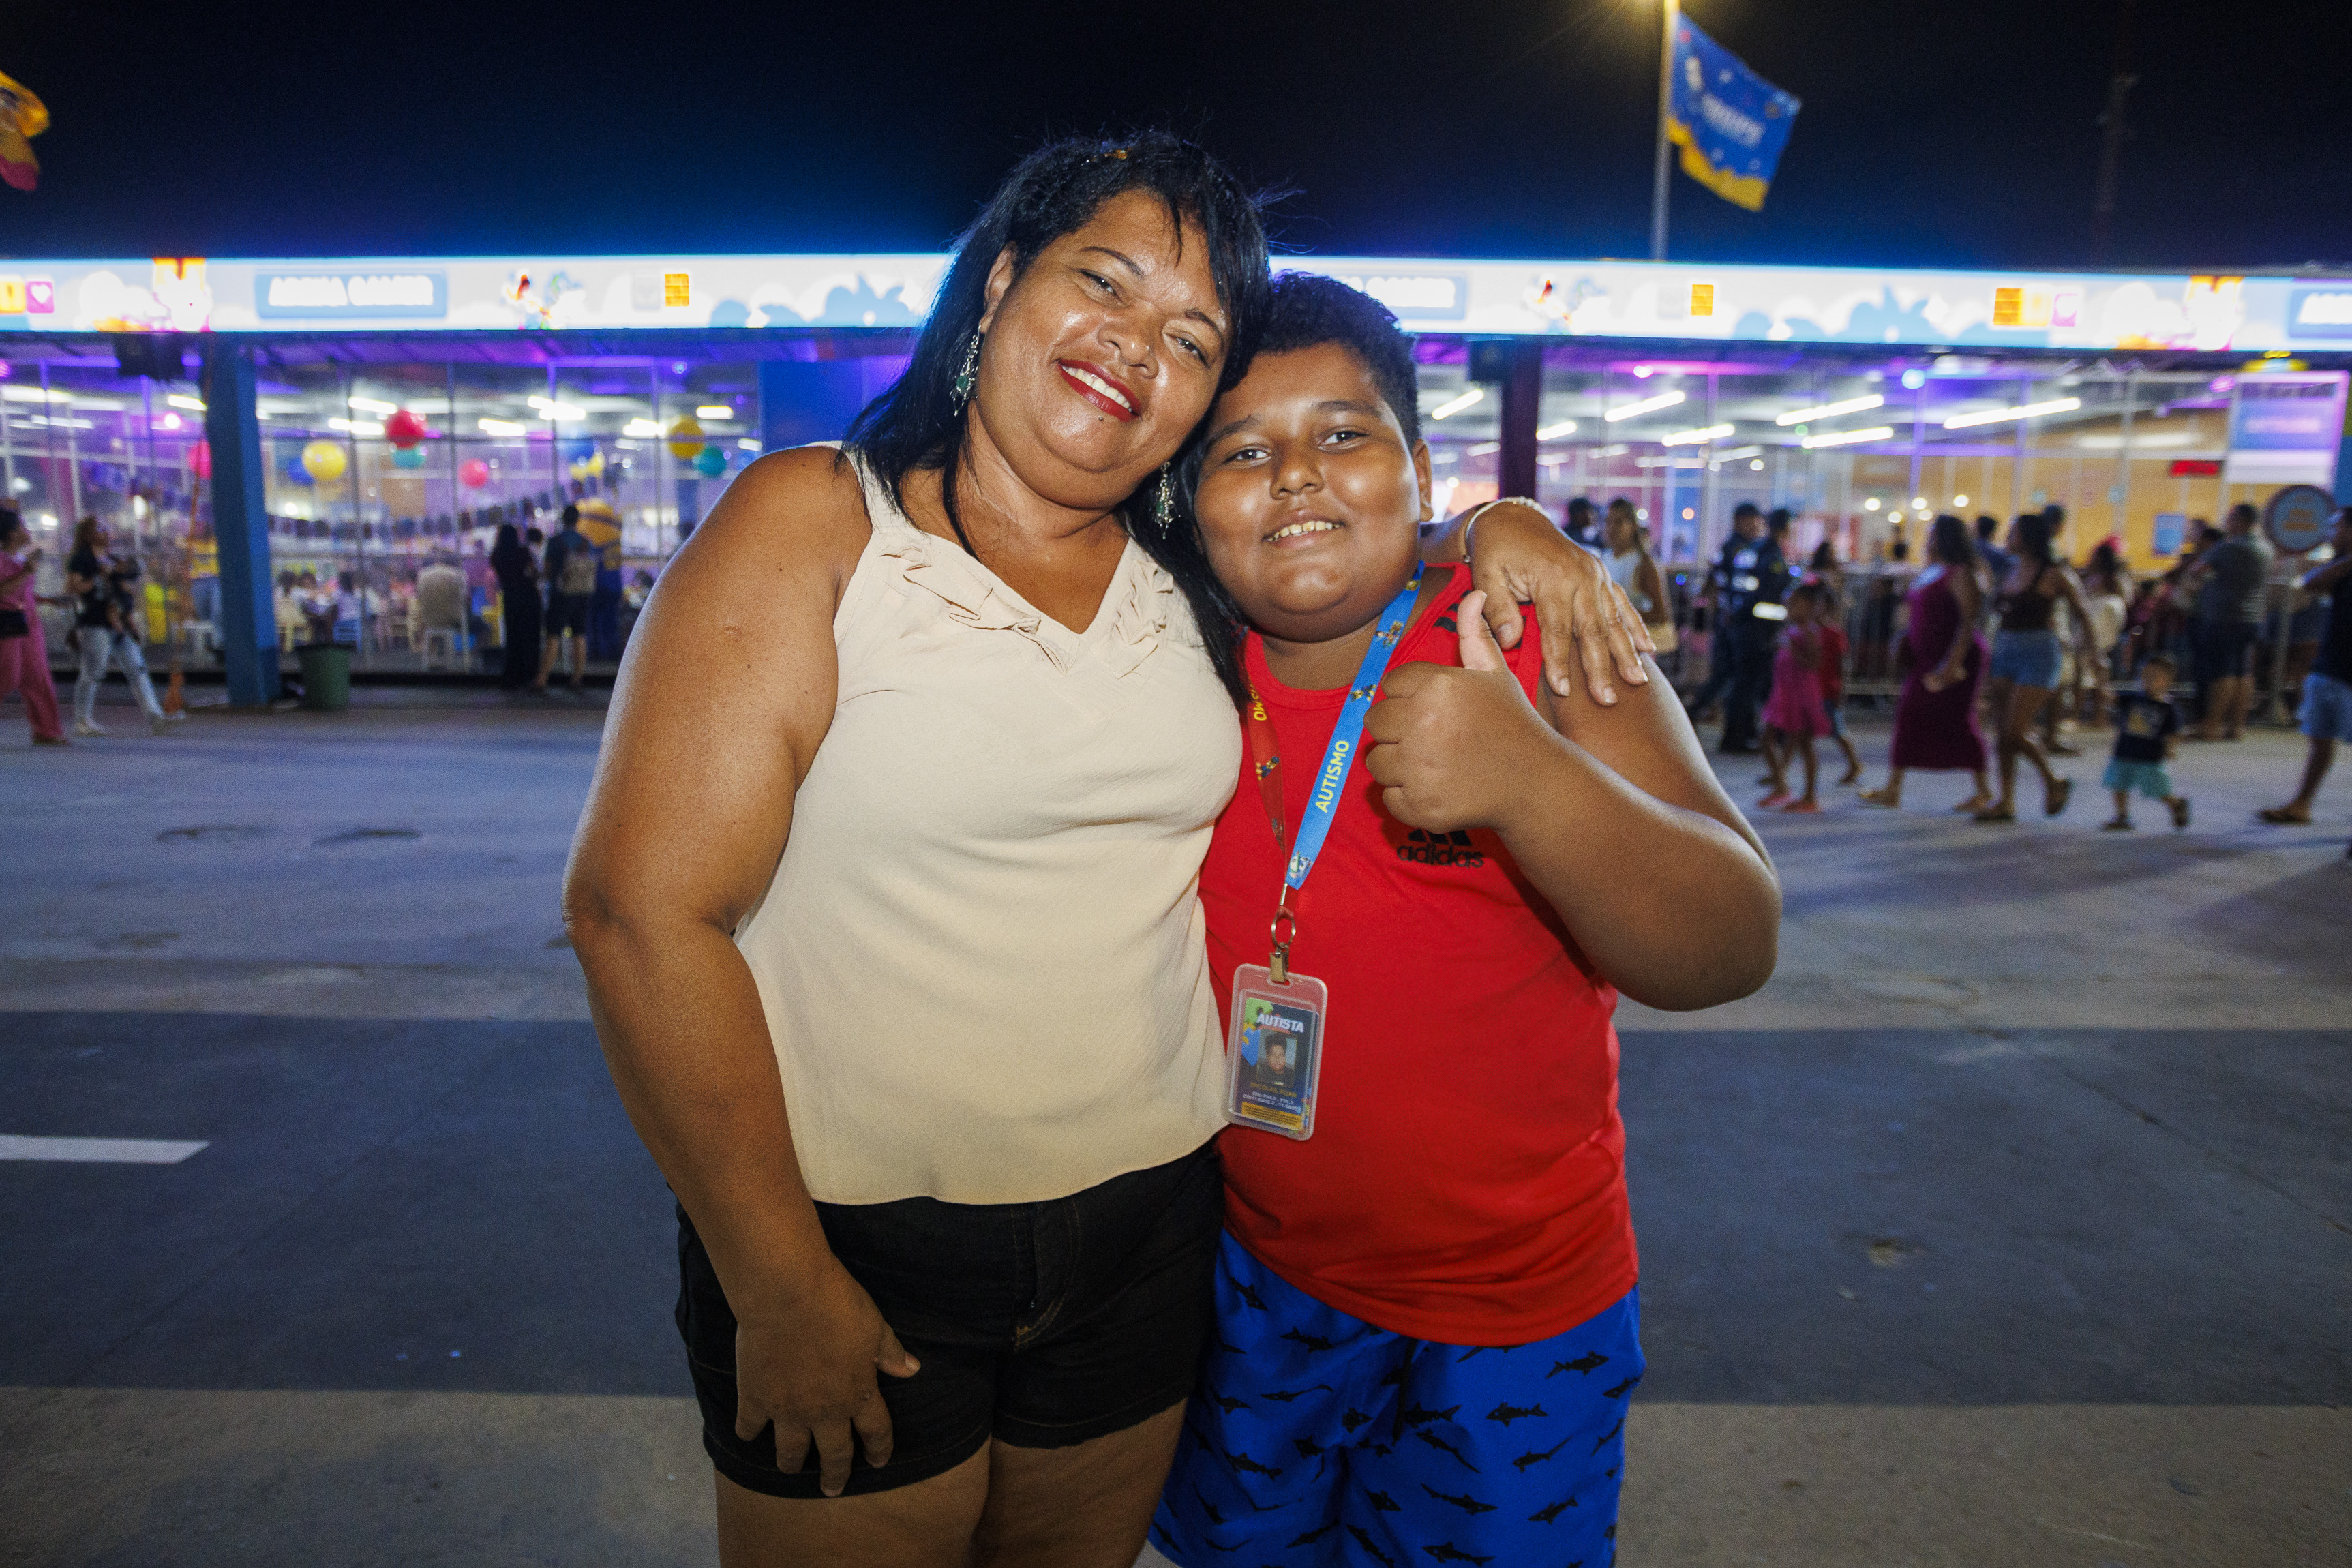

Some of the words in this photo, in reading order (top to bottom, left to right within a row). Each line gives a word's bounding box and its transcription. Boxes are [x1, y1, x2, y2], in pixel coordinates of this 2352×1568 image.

[1315, 740, 1349, 813] AUTISMO
[1397, 843, 1484, 869] adidas
[1256, 1013, 1303, 1033] AUTISTA
